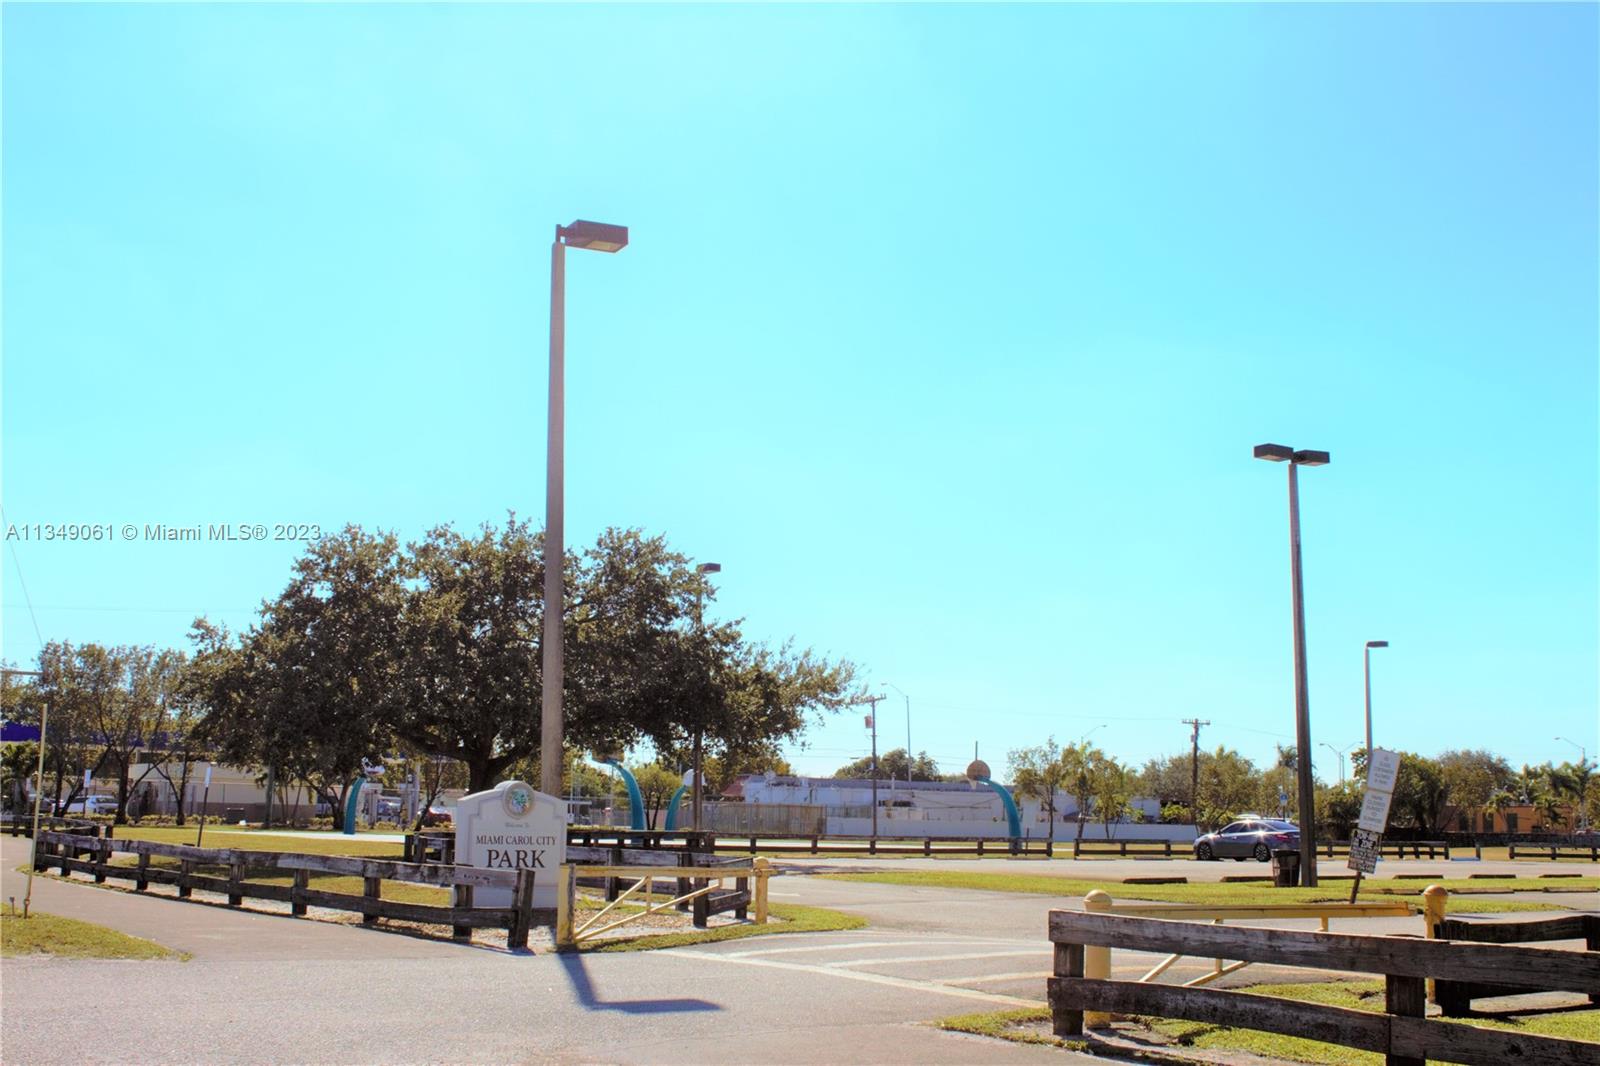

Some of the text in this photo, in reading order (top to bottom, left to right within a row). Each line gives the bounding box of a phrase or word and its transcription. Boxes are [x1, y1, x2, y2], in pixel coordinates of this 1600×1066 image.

[476, 835, 556, 846] MIAMI CAROL CITY
[487, 849, 546, 868] PARK
